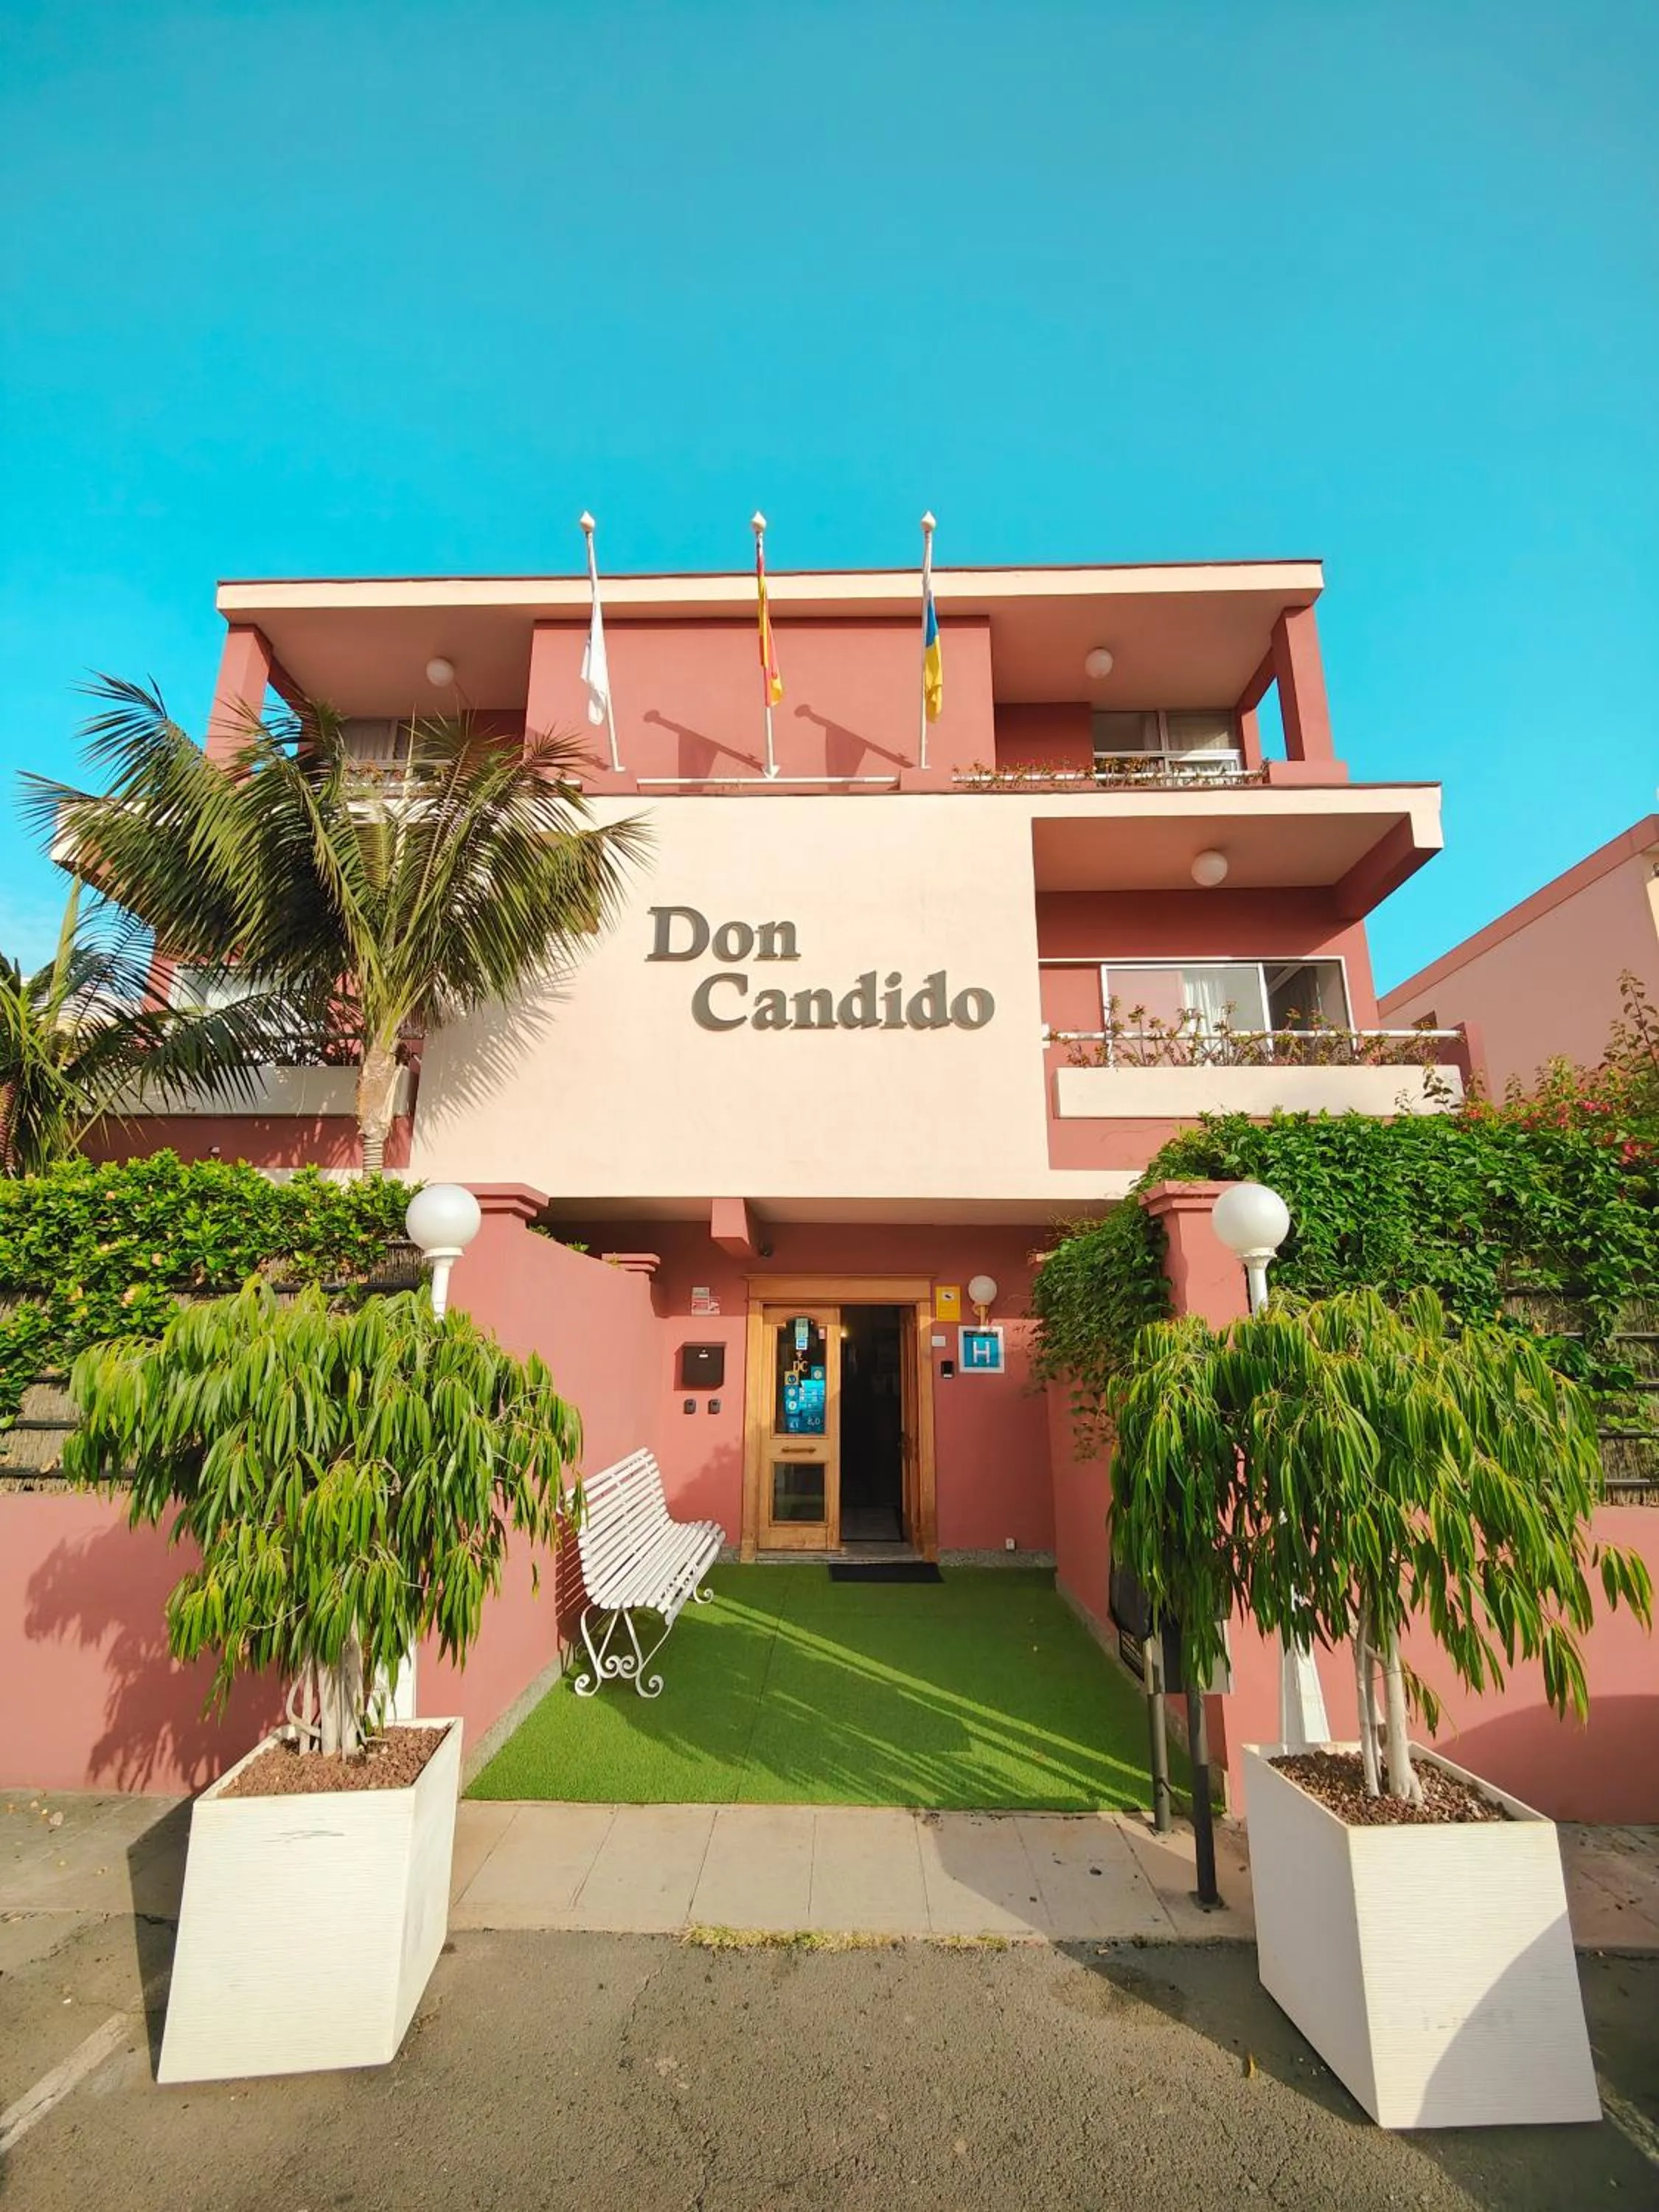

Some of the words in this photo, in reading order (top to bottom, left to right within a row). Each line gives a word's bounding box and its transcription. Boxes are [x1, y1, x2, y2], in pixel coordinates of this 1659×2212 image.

[644, 905, 801, 962] Don
[691, 970, 995, 1032] Candido
[973, 1341, 990, 1363] H
